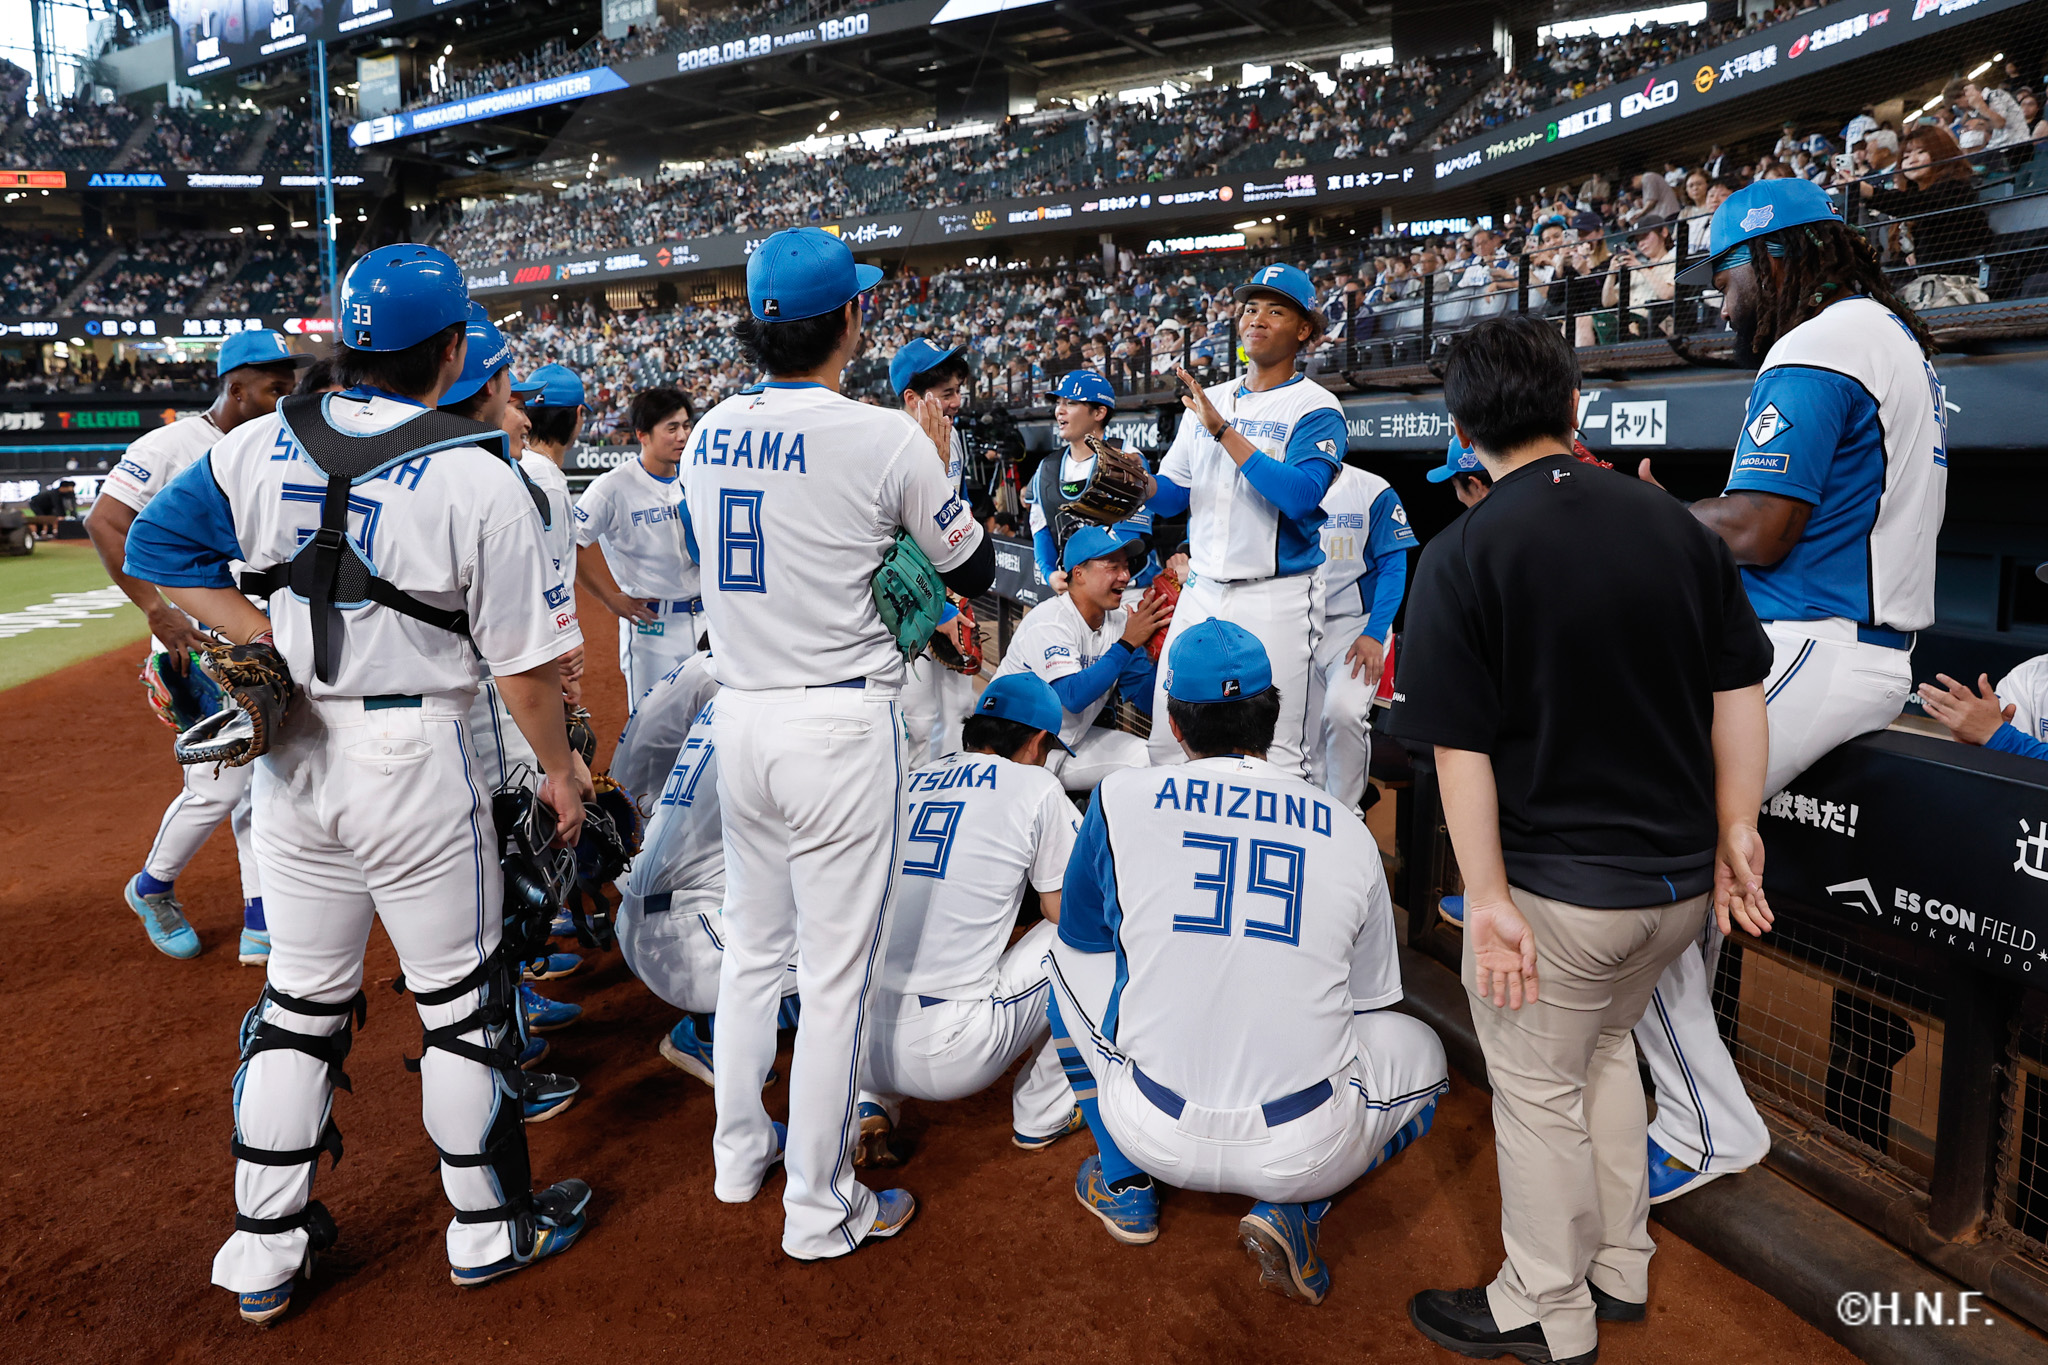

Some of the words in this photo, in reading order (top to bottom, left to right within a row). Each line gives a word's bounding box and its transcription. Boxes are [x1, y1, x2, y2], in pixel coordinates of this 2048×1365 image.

[677, 34, 772, 72] 2026.08.28
[774, 29, 817, 47] PLAYBALL
[818, 12, 869, 42] 18:00
[1719, 45, 1778, 84] 太平電業
[412, 104, 466, 130] HOKKAIDO
[467, 89, 533, 117] NIPPONHAM
[535, 76, 591, 102] FIGHTERS
[1620, 78, 1679, 119] EXEO
[88, 173, 167, 187] AIZAWA
[1327, 167, 1415, 191] 東日本フード
[1099, 196, 1138, 213] 日本ルナ
[841, 223, 903, 245] ハイボール
[513, 264, 551, 284] HBA
[1262, 266, 1285, 285] F
[352, 303, 372, 326] 33
[57, 410, 140, 429] 7-ELEVEN
[1195, 416, 1289, 443] FIHTERS
[1346, 418, 1374, 437] SMBC
[1615, 408, 1662, 439] ネット
[1755, 413, 1776, 440] F
[576, 446, 641, 469] docom
[693, 428, 807, 474] ASAMA
[1740, 457, 1779, 468] NEOBANK
[1323, 513, 1364, 529] ERS
[718, 488, 767, 595] 8
[915, 573, 934, 600] Wilson
[908, 763, 998, 793] TSUKA
[1154, 777, 1332, 838] ARIZONO
[1760, 789, 1859, 838] 飲料だ!
[902, 801, 966, 880] 9
[1172, 830, 1306, 947] 39
[1894, 887, 1921, 914] ES
[1924, 898, 1976, 933] CON
[1980, 916, 2037, 951] FIELD
[1893, 915, 2032, 972] HOKKAIDO
